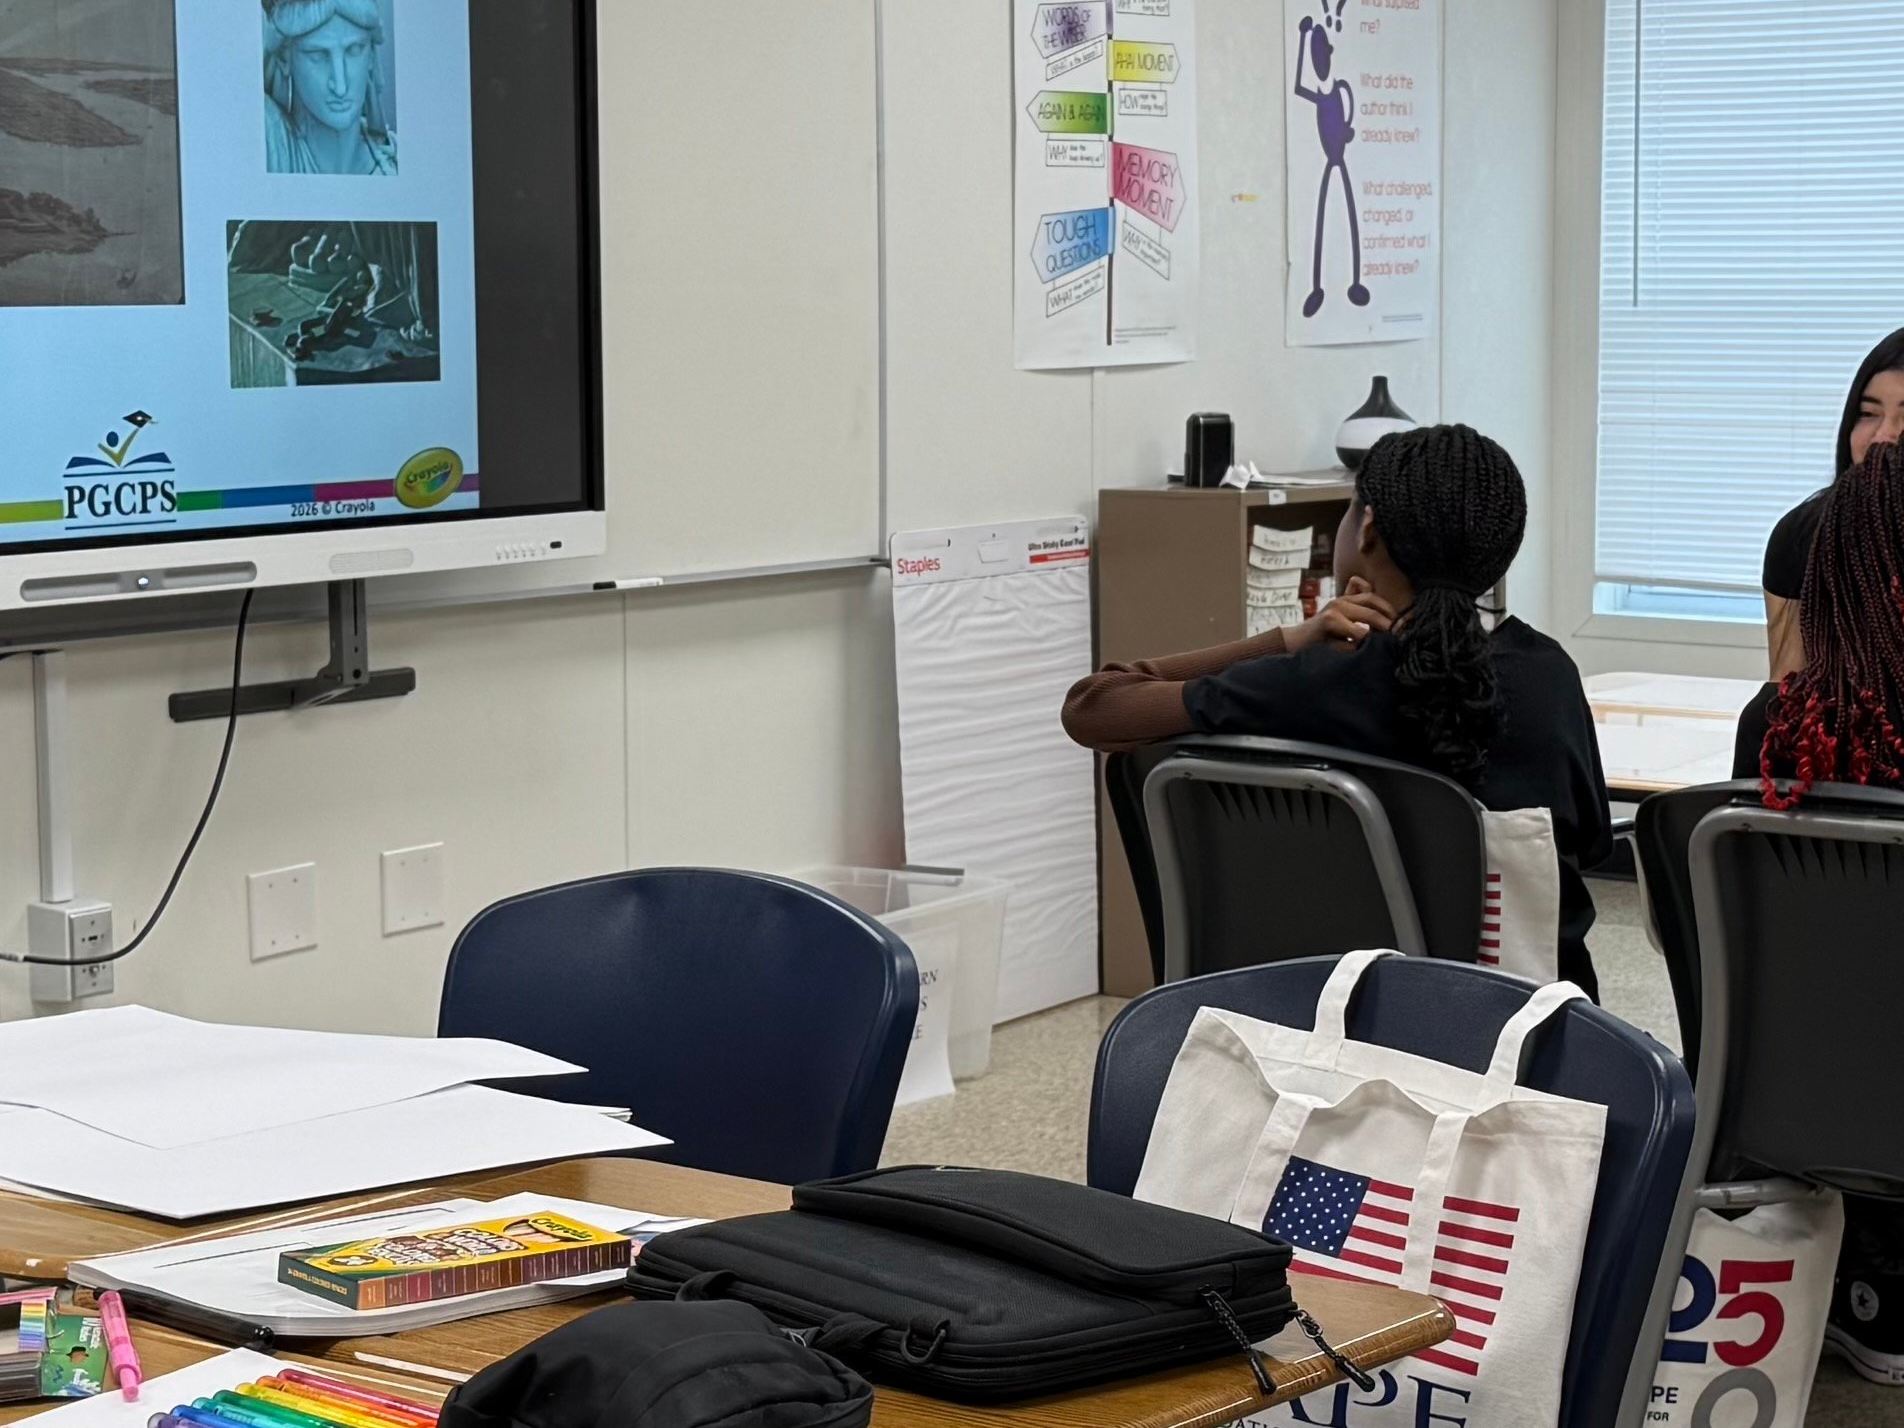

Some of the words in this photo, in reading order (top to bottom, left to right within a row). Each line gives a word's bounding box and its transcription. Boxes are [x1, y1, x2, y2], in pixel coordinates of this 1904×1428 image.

[1042, 6, 1079, 26] WORDS
[1360, 20, 1380, 35] me?
[1360, 74, 1383, 90] What
[1038, 103, 1066, 121] AGAIN
[1117, 147, 1178, 188] MEMORY
[1119, 174, 1173, 221] MOMENT
[1362, 181, 1383, 196] What
[1044, 216, 1096, 245] TOUGH
[1046, 239, 1101, 273] QUESTIONS
[406, 460, 450, 484] Crayola
[65, 480, 177, 519] PGCPS
[291, 502, 318, 517] 2026
[335, 499, 375, 516] Crayola
[896, 555, 941, 576] Staples
[531, 1218, 593, 1241] Crayola
[1647, 1411, 1669, 1421] FOR
